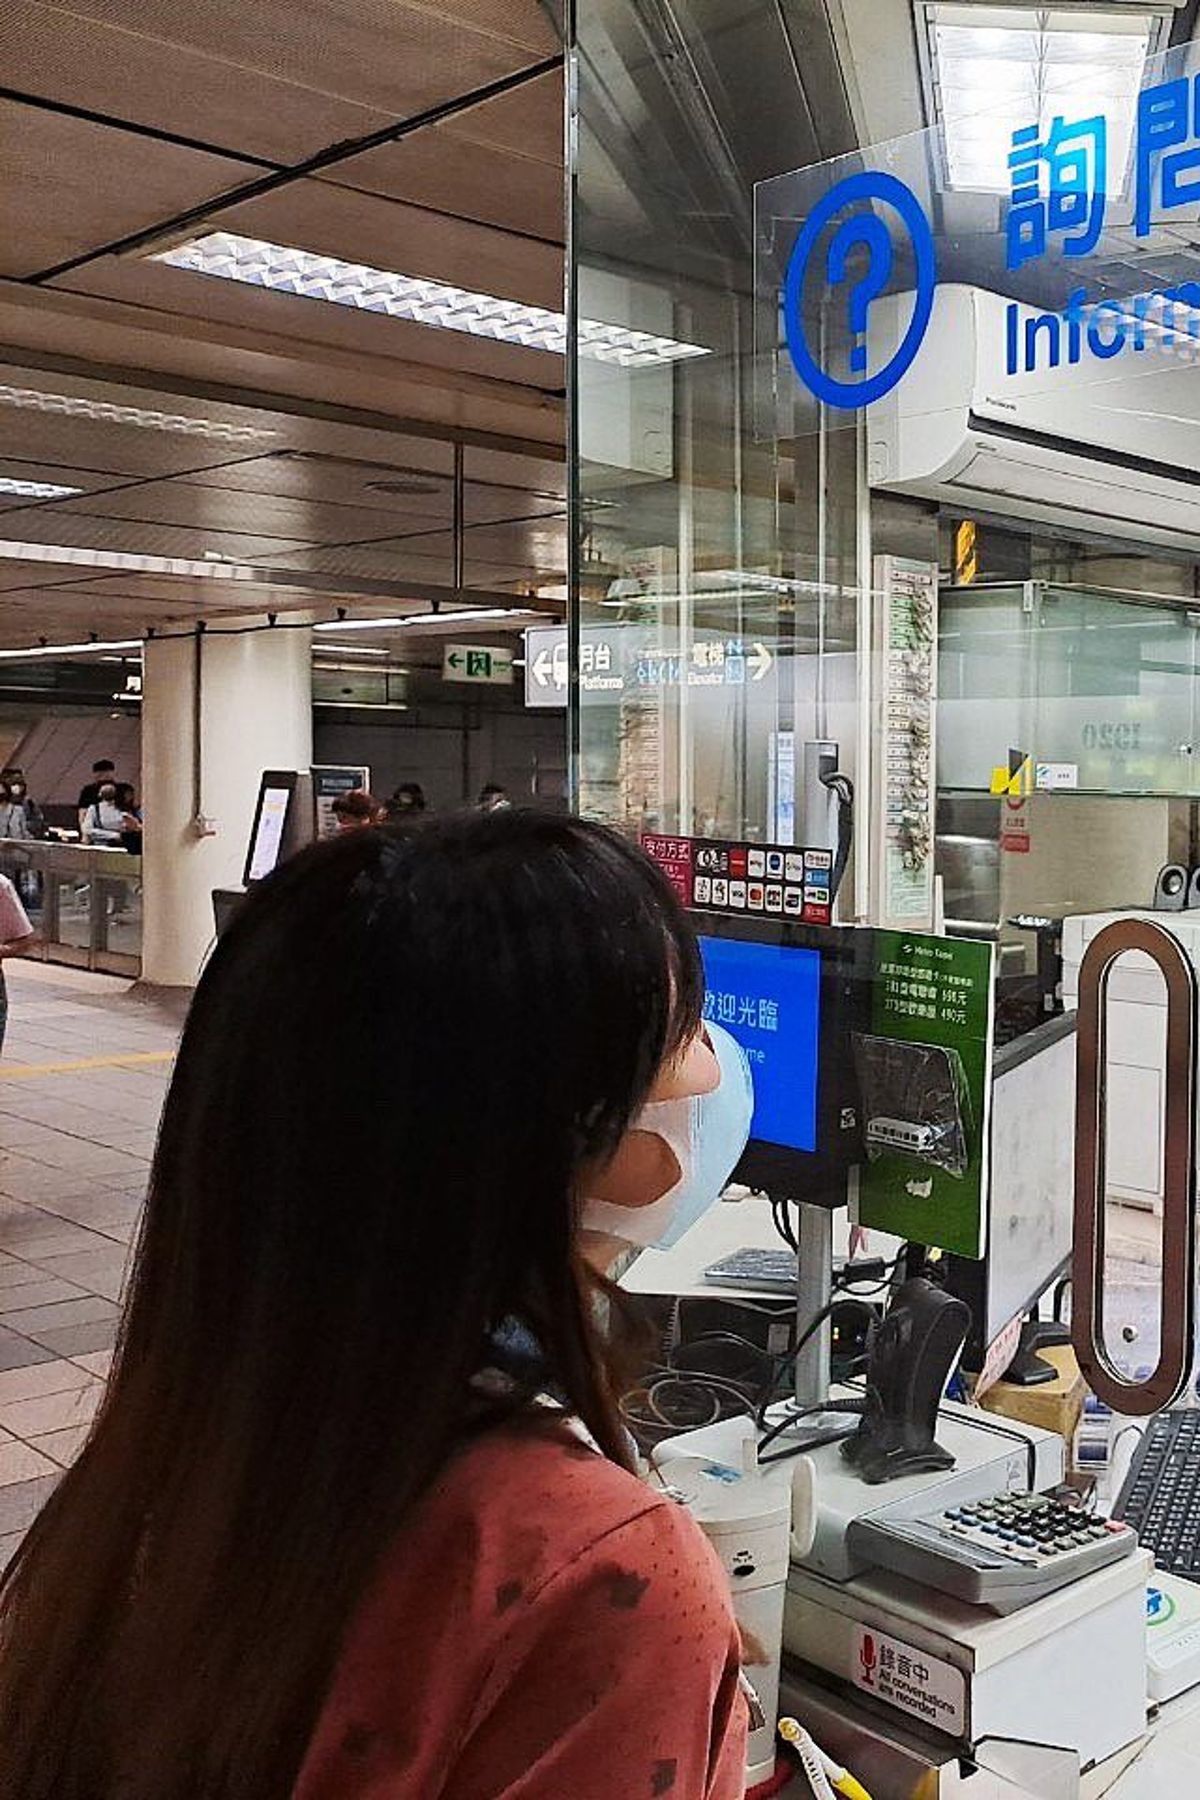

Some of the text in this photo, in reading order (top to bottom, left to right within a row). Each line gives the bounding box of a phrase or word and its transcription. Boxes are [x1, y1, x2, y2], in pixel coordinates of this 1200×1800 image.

[880, 1644, 929, 1684] 錄音中
[892, 1677, 956, 1715] conversations
